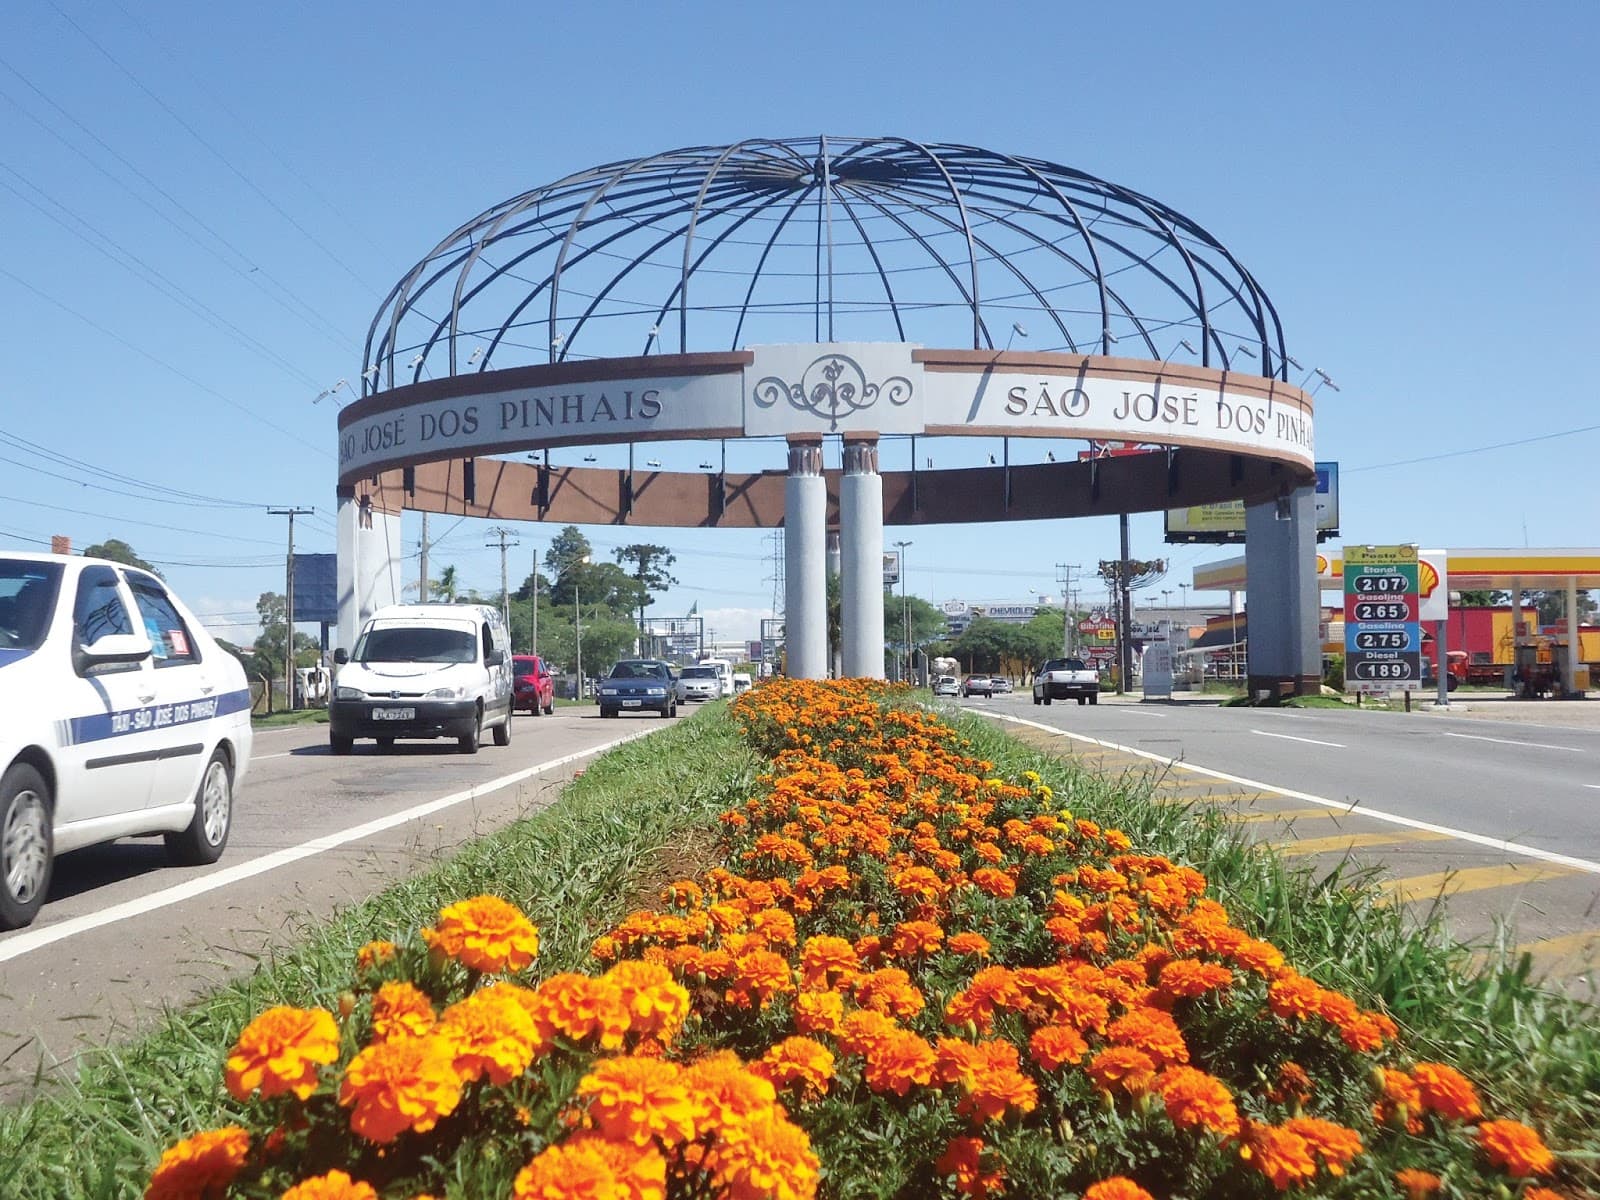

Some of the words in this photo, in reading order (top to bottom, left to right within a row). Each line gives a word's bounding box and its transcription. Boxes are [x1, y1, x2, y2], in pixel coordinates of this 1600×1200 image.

[1004, 382, 1090, 418] SÃO
[1113, 392, 1199, 426] JOSÉ
[1215, 402, 1266, 434] DOS
[361, 412, 406, 454] JOSÉ
[421, 406, 479, 442] DOS
[500, 389, 663, 430] PINHAIS
[1363, 566, 1397, 574] Etanol
[1357, 593, 1404, 602] Gasolina
[1358, 622, 1405, 630] Gasolina
[1368, 664, 1401, 677] 189
